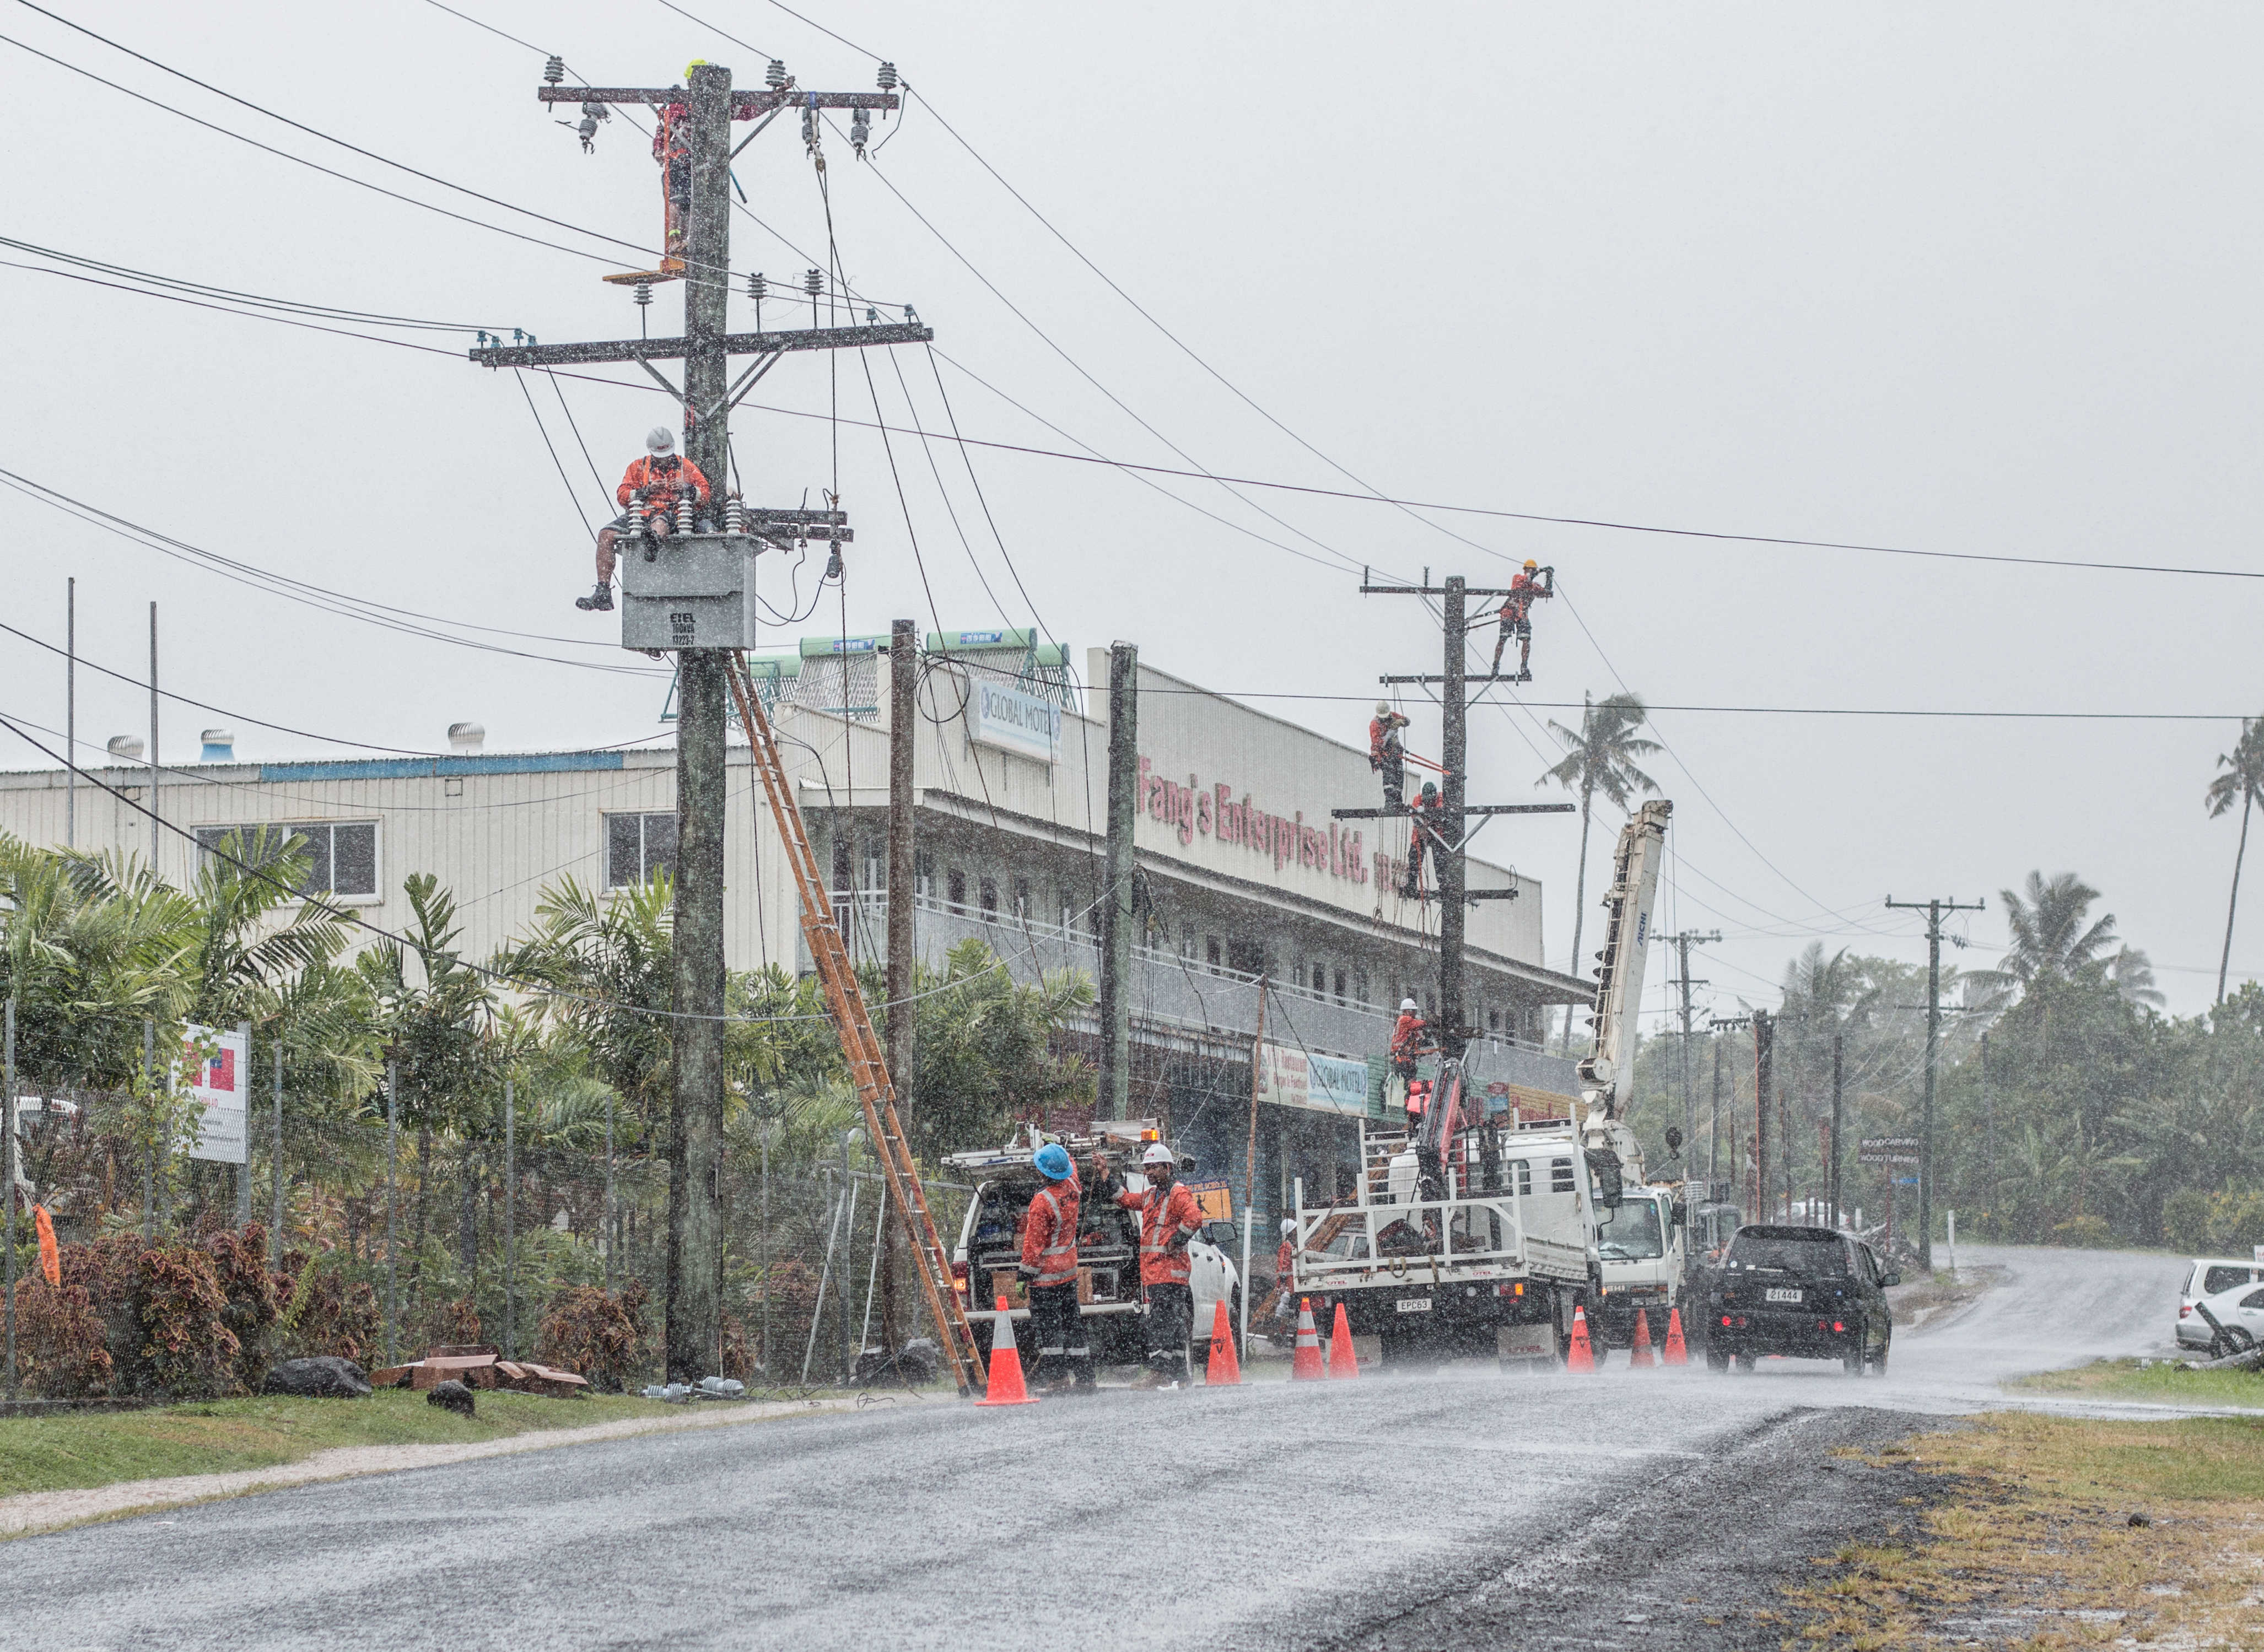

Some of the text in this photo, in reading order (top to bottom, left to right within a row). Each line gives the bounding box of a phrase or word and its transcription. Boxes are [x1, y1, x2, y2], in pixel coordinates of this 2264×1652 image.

[672, 635, 694, 645] 13223-2
[990, 692, 1023, 727] GLOBAL
[1136, 755, 1213, 846] Fang's
[1215, 782, 1328, 873] Enterprise
[1330, 822, 1368, 884] Ltd.
[1637, 912, 1647, 947] AICHI
[1316, 1064, 1361, 1094] GLOBAL MOTEL
[1862, 1137, 1919, 1147] WOOD CARVING
[1861, 1154, 1920, 1163] WOOD TURNING
[1204, 1180, 1227, 1190] SCHOOL
[1771, 1290, 1798, 1300] 21444
[1401, 1300, 1428, 1310] EPC63
